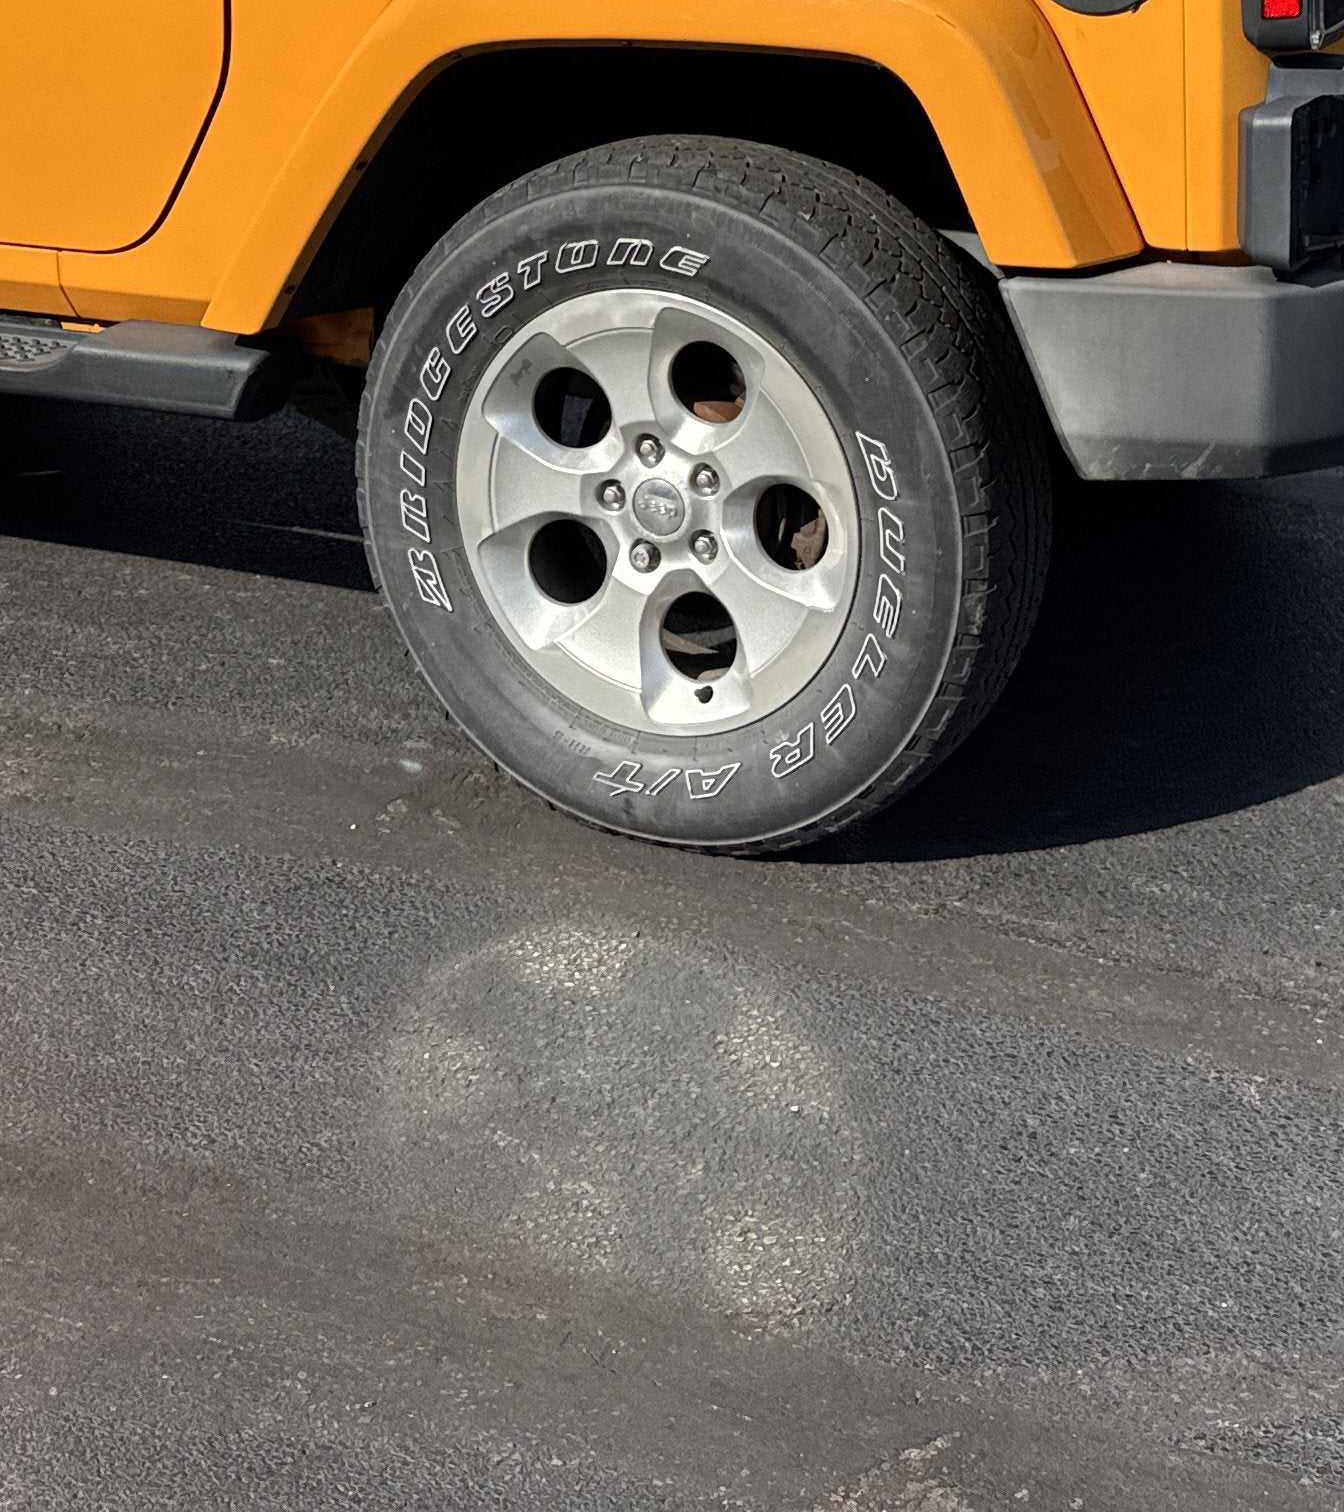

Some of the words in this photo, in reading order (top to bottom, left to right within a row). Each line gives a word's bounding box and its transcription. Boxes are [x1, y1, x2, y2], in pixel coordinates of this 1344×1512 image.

[399, 237, 710, 612] BRIDGESTONE
[770, 431, 907, 779] DUELER
[593, 760, 743, 800] A/T
